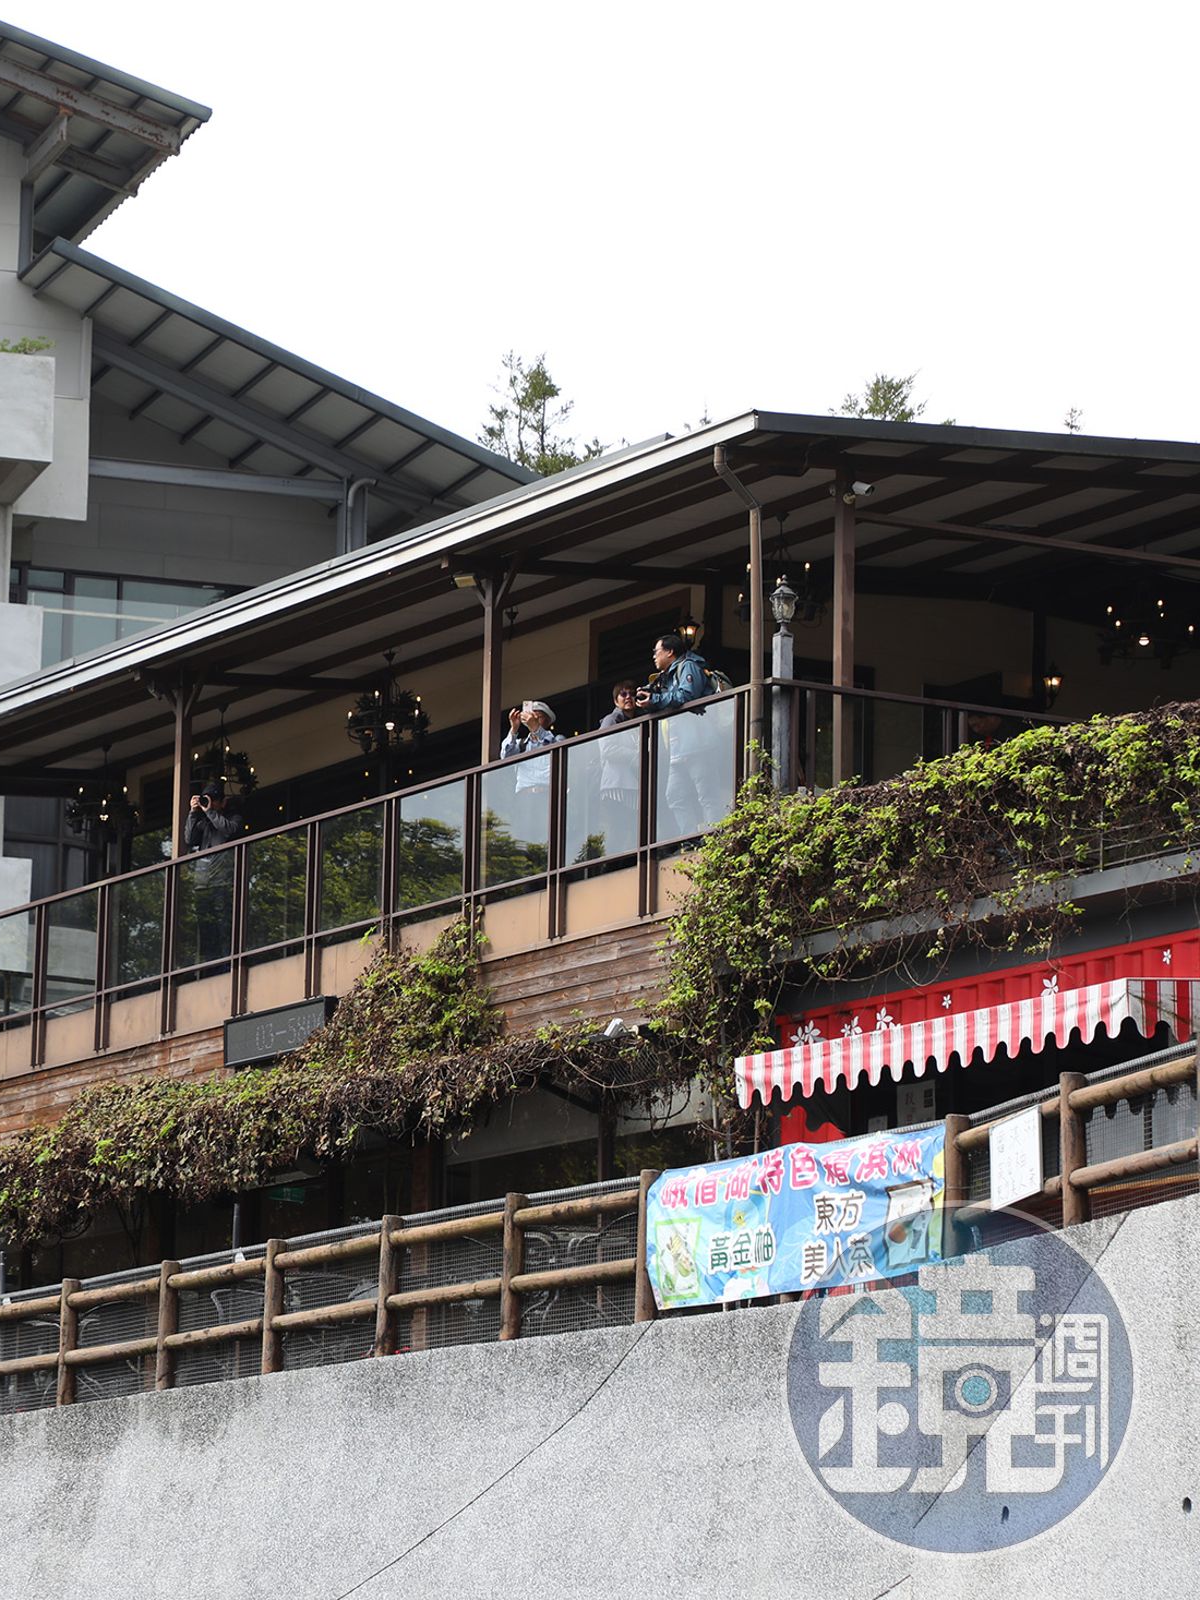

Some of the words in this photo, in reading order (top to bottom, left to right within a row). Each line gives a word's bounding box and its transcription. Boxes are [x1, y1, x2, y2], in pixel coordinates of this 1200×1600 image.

[815, 1193, 864, 1231] 東方
[709, 1229, 774, 1271] 黃金柚
[803, 1238, 876, 1279] 美人茶
